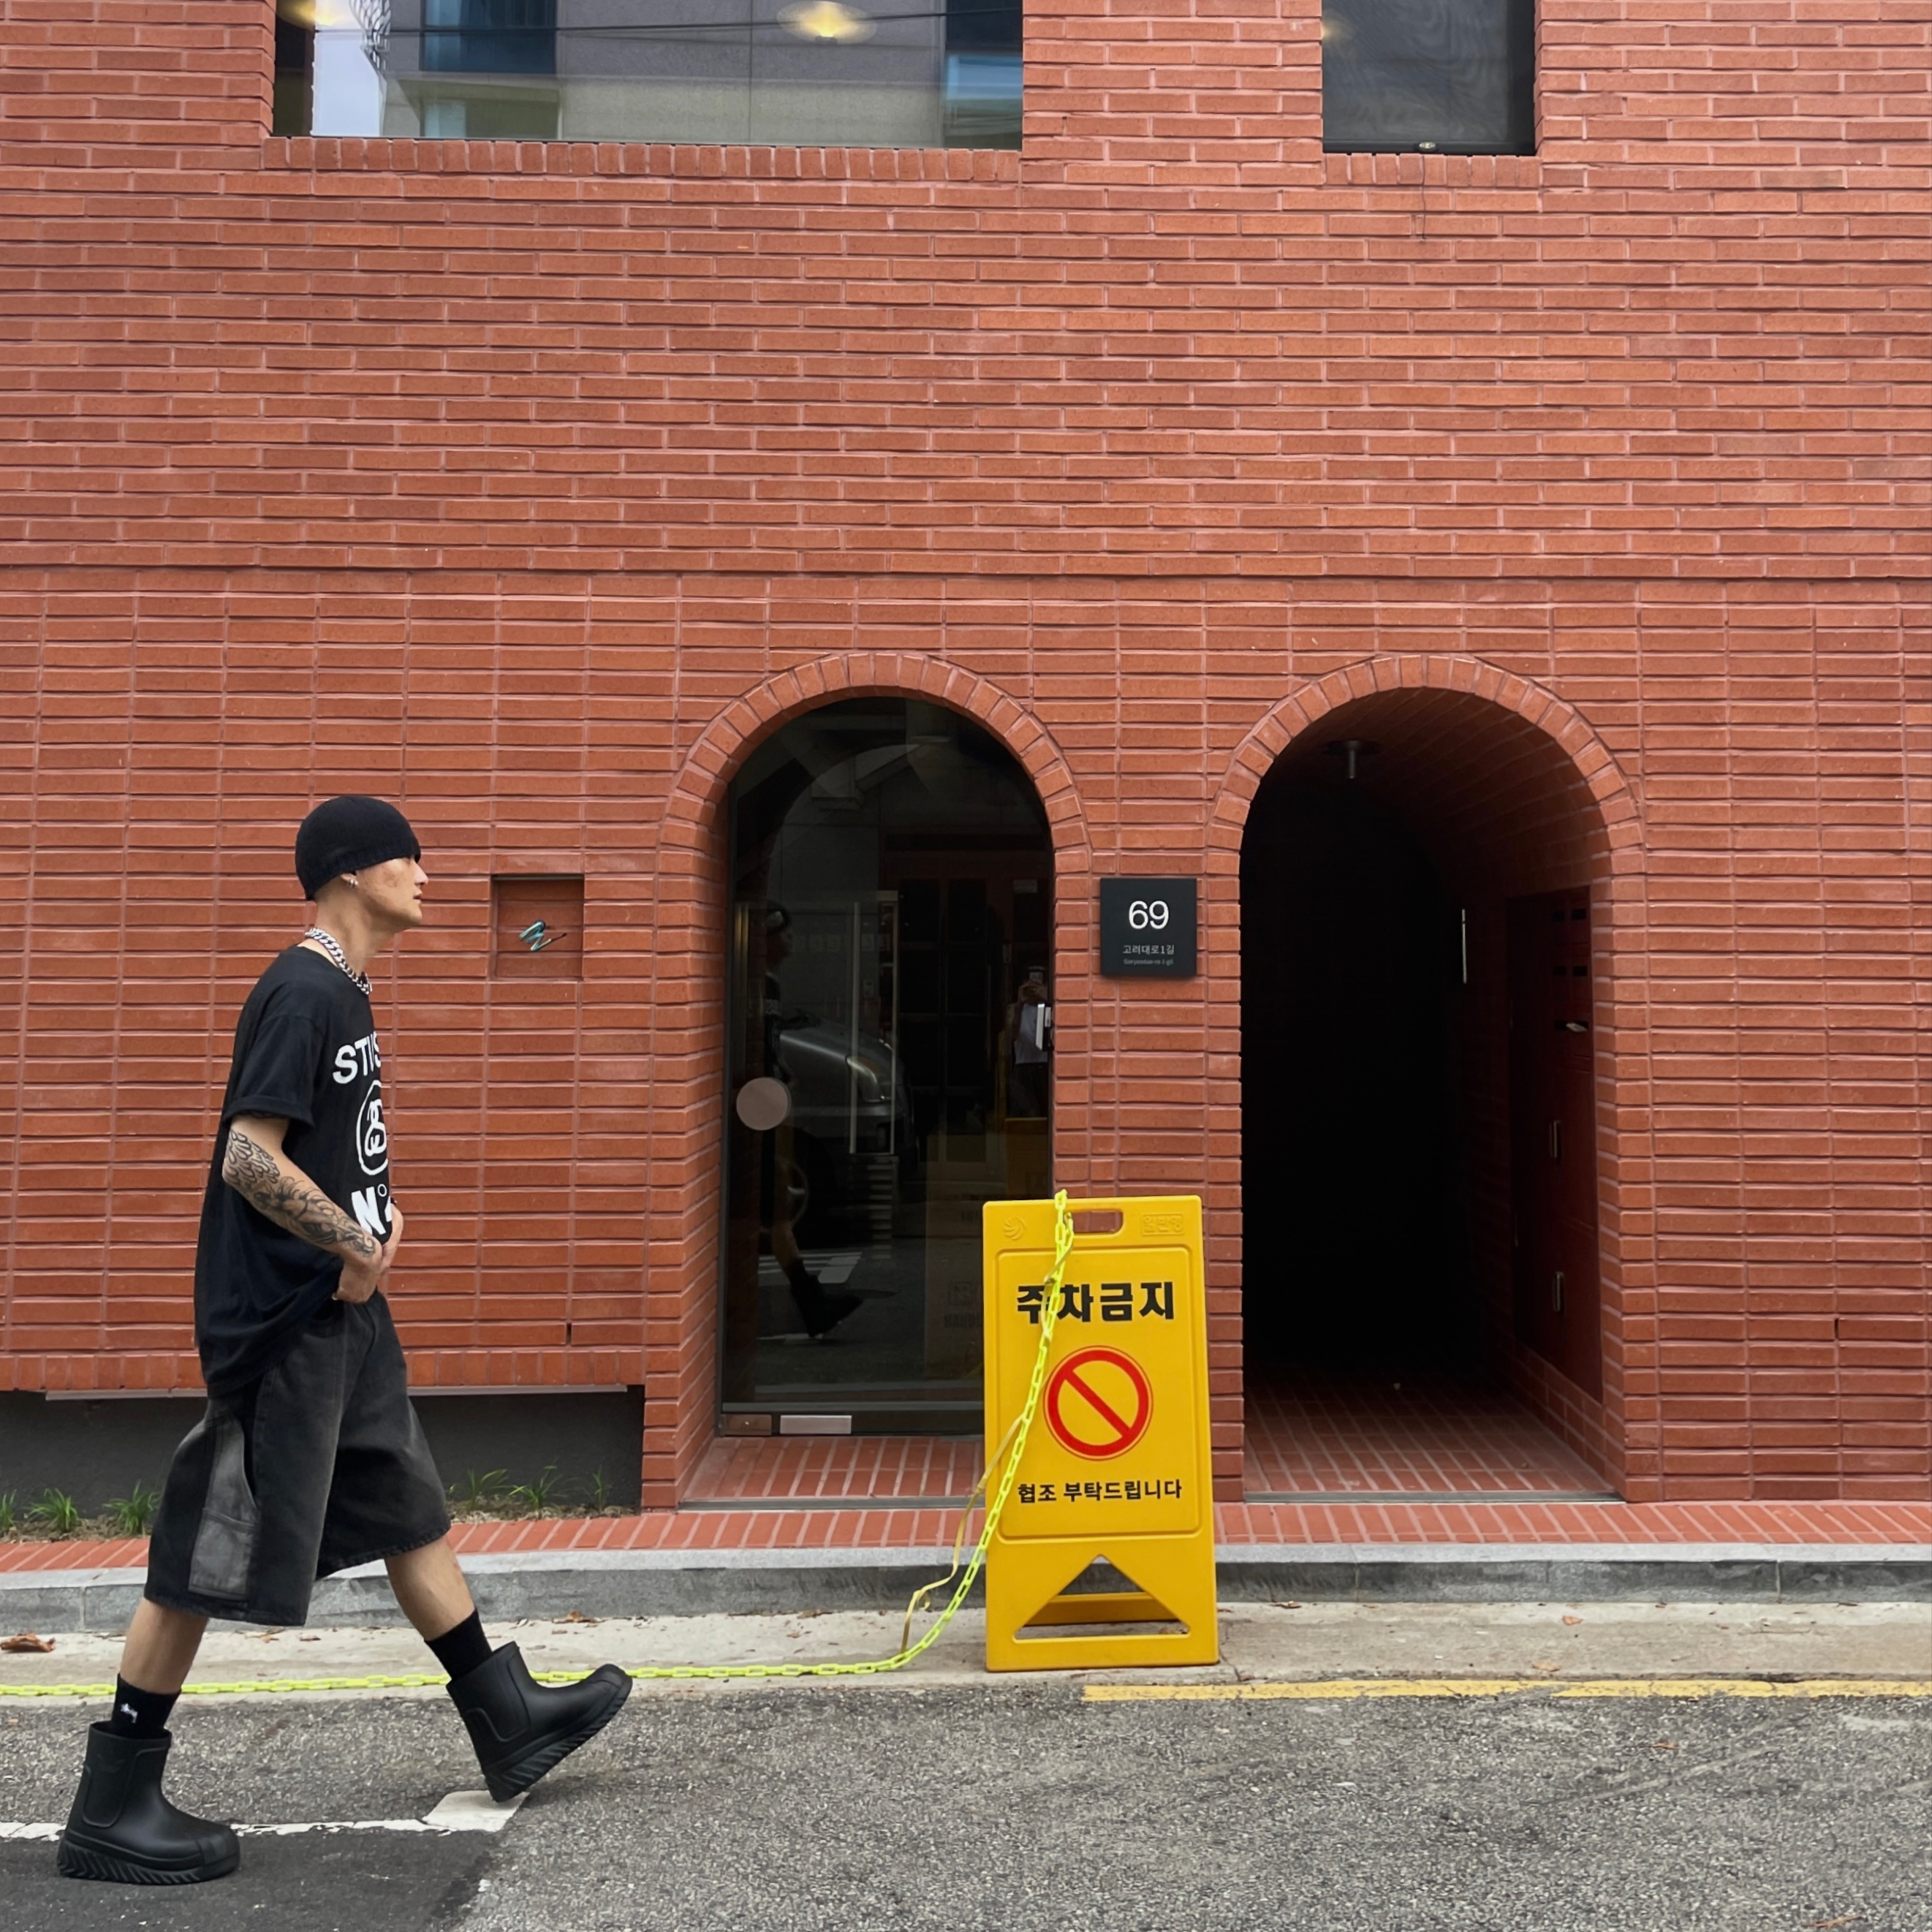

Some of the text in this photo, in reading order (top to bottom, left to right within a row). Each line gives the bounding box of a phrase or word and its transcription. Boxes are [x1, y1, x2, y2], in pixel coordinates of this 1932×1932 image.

[1129, 900, 1169, 930] 69
[1123, 944, 1175, 955] 고려대로1길
[1017, 1281, 1174, 1325] 주차금지
[1018, 1479, 1182, 1504] 협조 부탁드립니다
